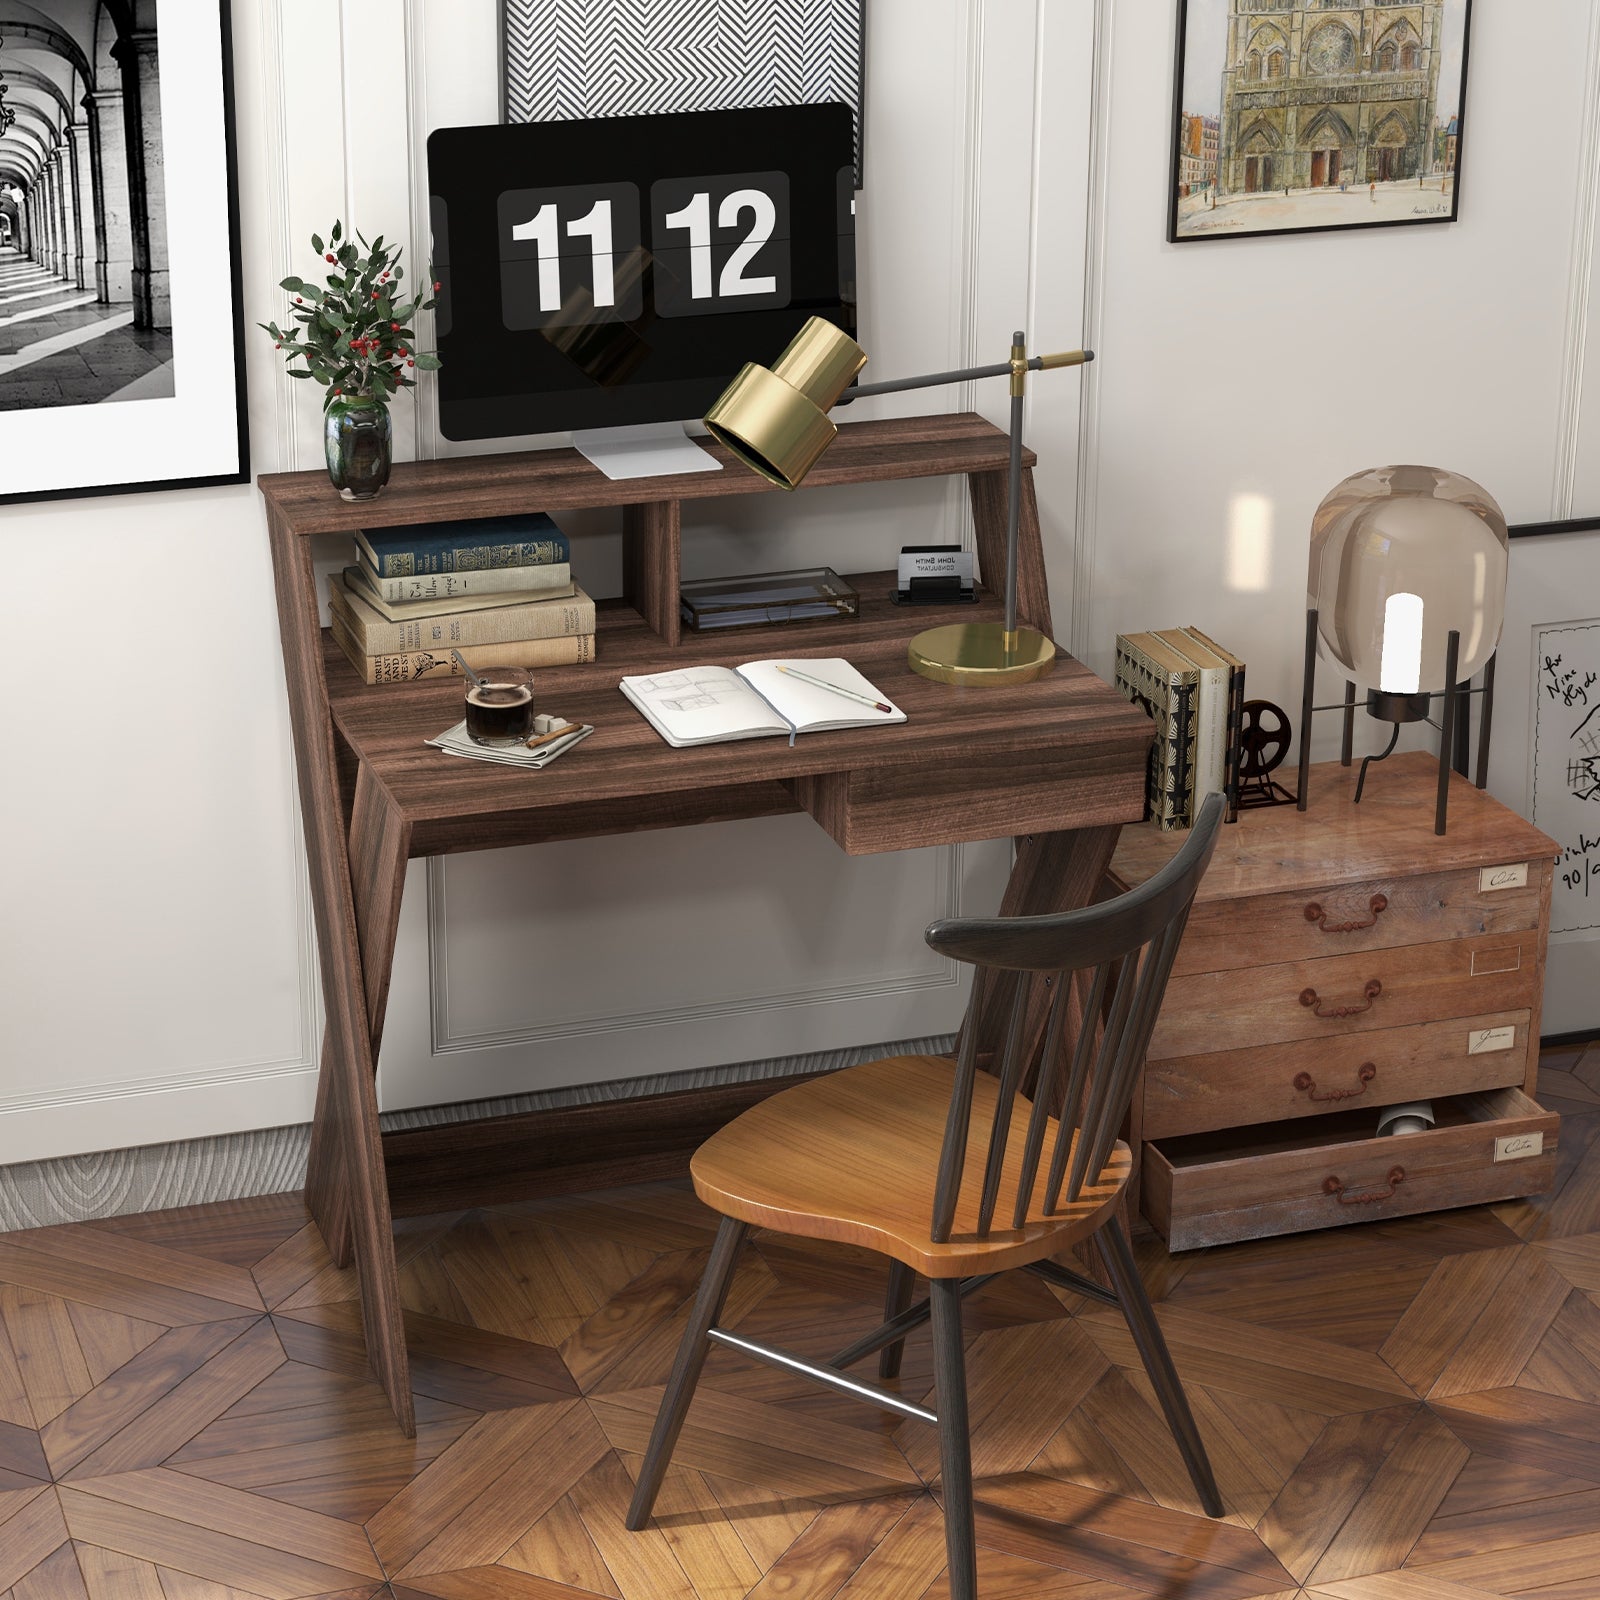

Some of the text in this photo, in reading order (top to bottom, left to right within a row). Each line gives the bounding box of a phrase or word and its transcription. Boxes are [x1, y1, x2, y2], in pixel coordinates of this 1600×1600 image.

[512, 189, 776, 312] 11 12
[392, 658, 400, 681] AND
[400, 653, 409, 681] WEST
